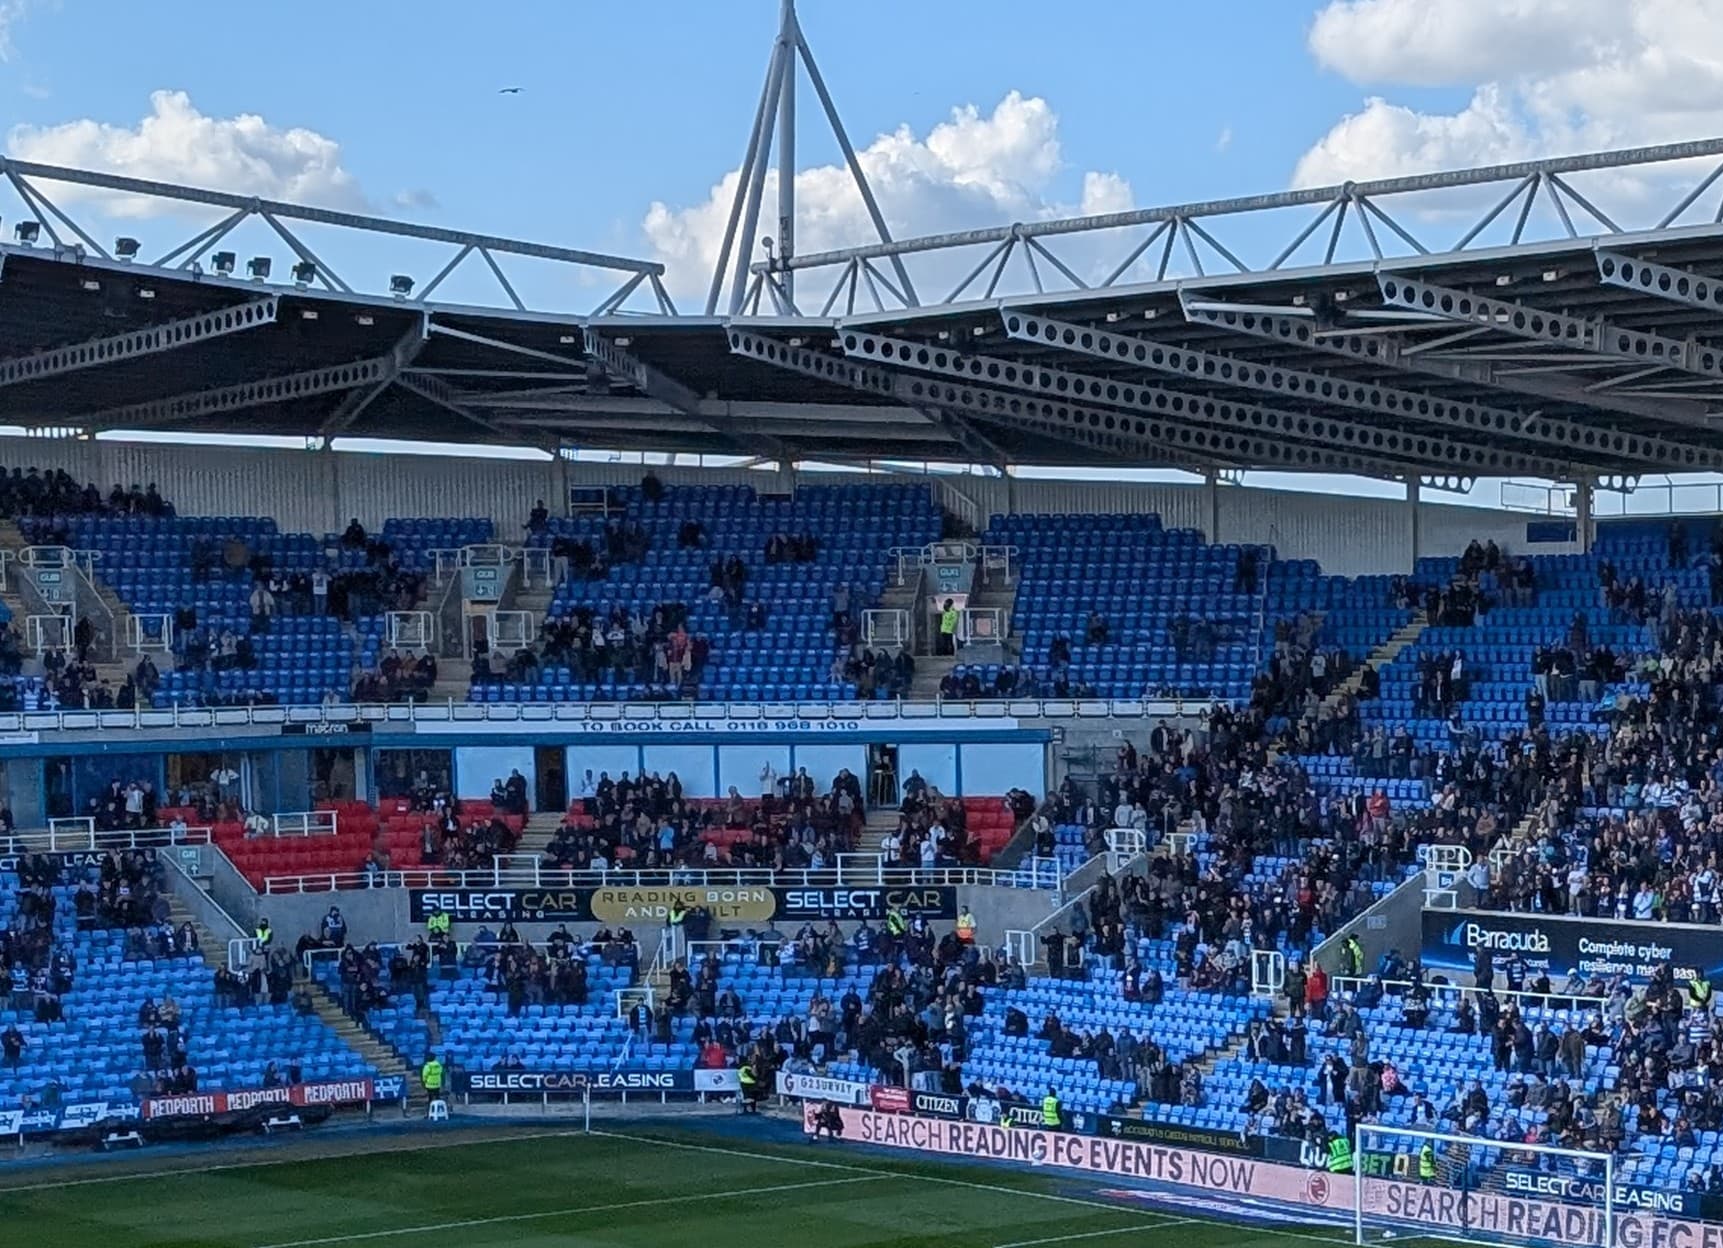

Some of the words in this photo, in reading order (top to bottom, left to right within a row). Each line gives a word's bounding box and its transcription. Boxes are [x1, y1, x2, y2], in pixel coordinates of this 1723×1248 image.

[581, 722, 603, 731] TO
[669, 722, 715, 731] CALL
[422, 893, 516, 910] SELECT
[522, 893, 577, 910] CAR
[602, 890, 696, 903] READING
[706, 889, 765, 902] BORN
[786, 890, 880, 908] SELECT
[886, 890, 942, 907] CAR
[456, 911, 545, 919] LEASING
[625, 906, 668, 918] AND
[1467, 923, 1549, 952] Barracuda
[1579, 937, 1636, 959] Complete
[1638, 942, 1673, 962] cyber
[916, 1094, 959, 1114] CITIZEN
[1009, 1106, 1044, 1124] CITIZ
[862, 1112, 943, 1150] SEARCH
[949, 1124, 1047, 1161] READING
[1054, 1135, 1083, 1165] FC
[1090, 1140, 1183, 1180] EVENTS
[1190, 1154, 1256, 1193] NOW
[1387, 1184, 1498, 1230] SEARCH
